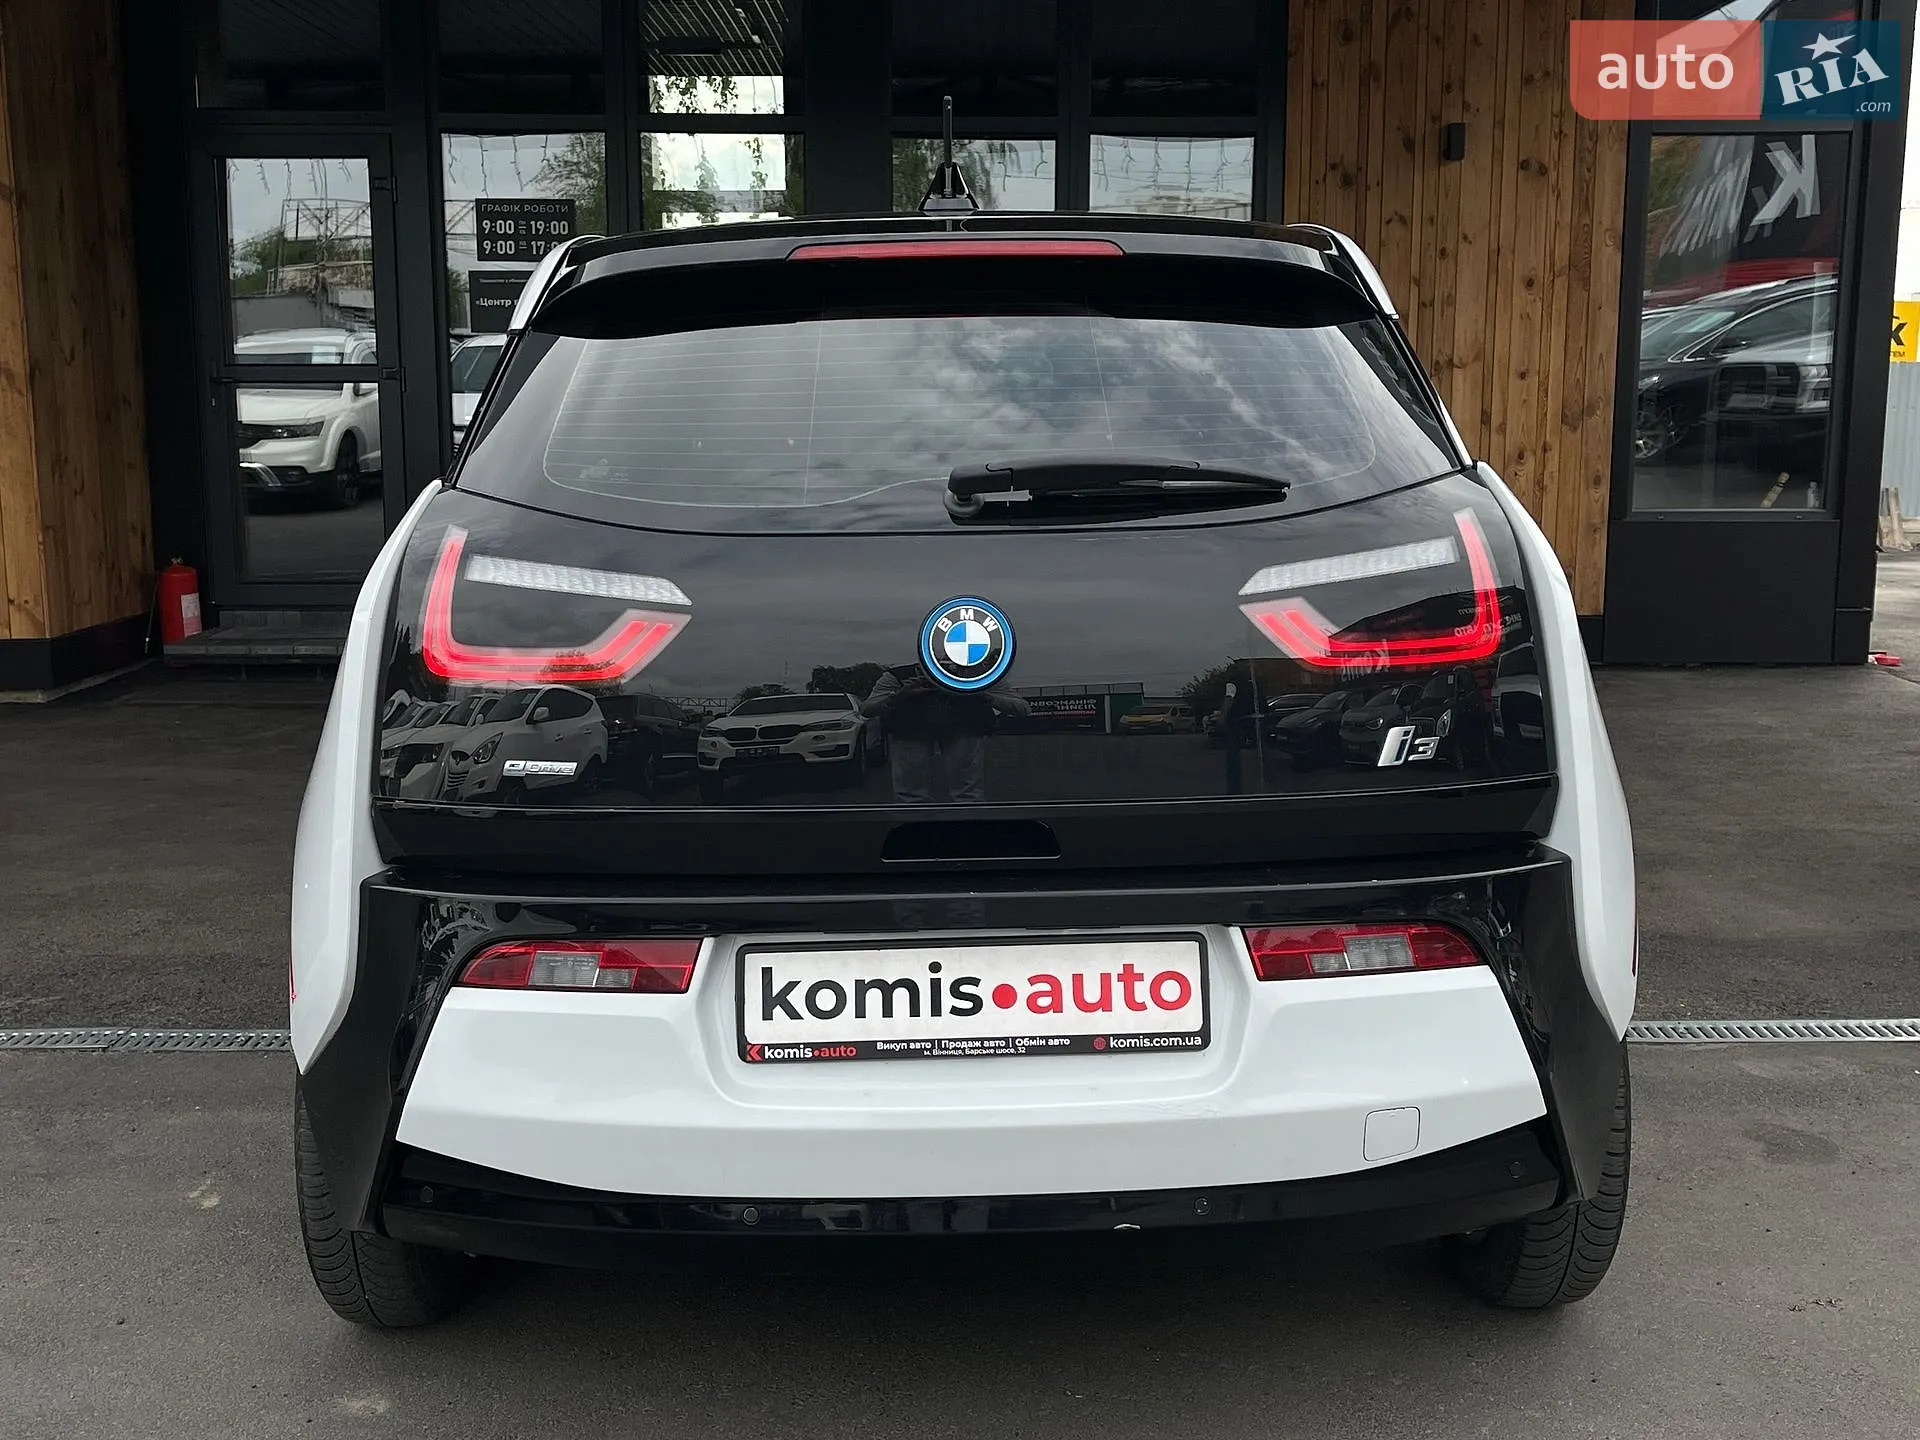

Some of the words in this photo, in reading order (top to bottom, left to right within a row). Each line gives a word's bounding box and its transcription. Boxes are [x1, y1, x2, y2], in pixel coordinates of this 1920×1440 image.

[481, 204, 521, 213] ГРАФІК
[524, 205, 569, 213] РОБОТИ
[482, 220, 515, 234] 9:00
[530, 221, 569, 235] 19:00
[483, 241, 515, 255] 9:00
[937, 608, 998, 632] BMW
[1377, 726, 1440, 766] i3
[876, 1041, 907, 1051] Викуп
[941, 1040, 981, 1049] Продаж
[983, 1040, 1006, 1048] авто
[1015, 1037, 1046, 1046] Обмін
[1047, 1038, 1070, 1046] авто
[1109, 1036, 1202, 1049] komis.com.ua
